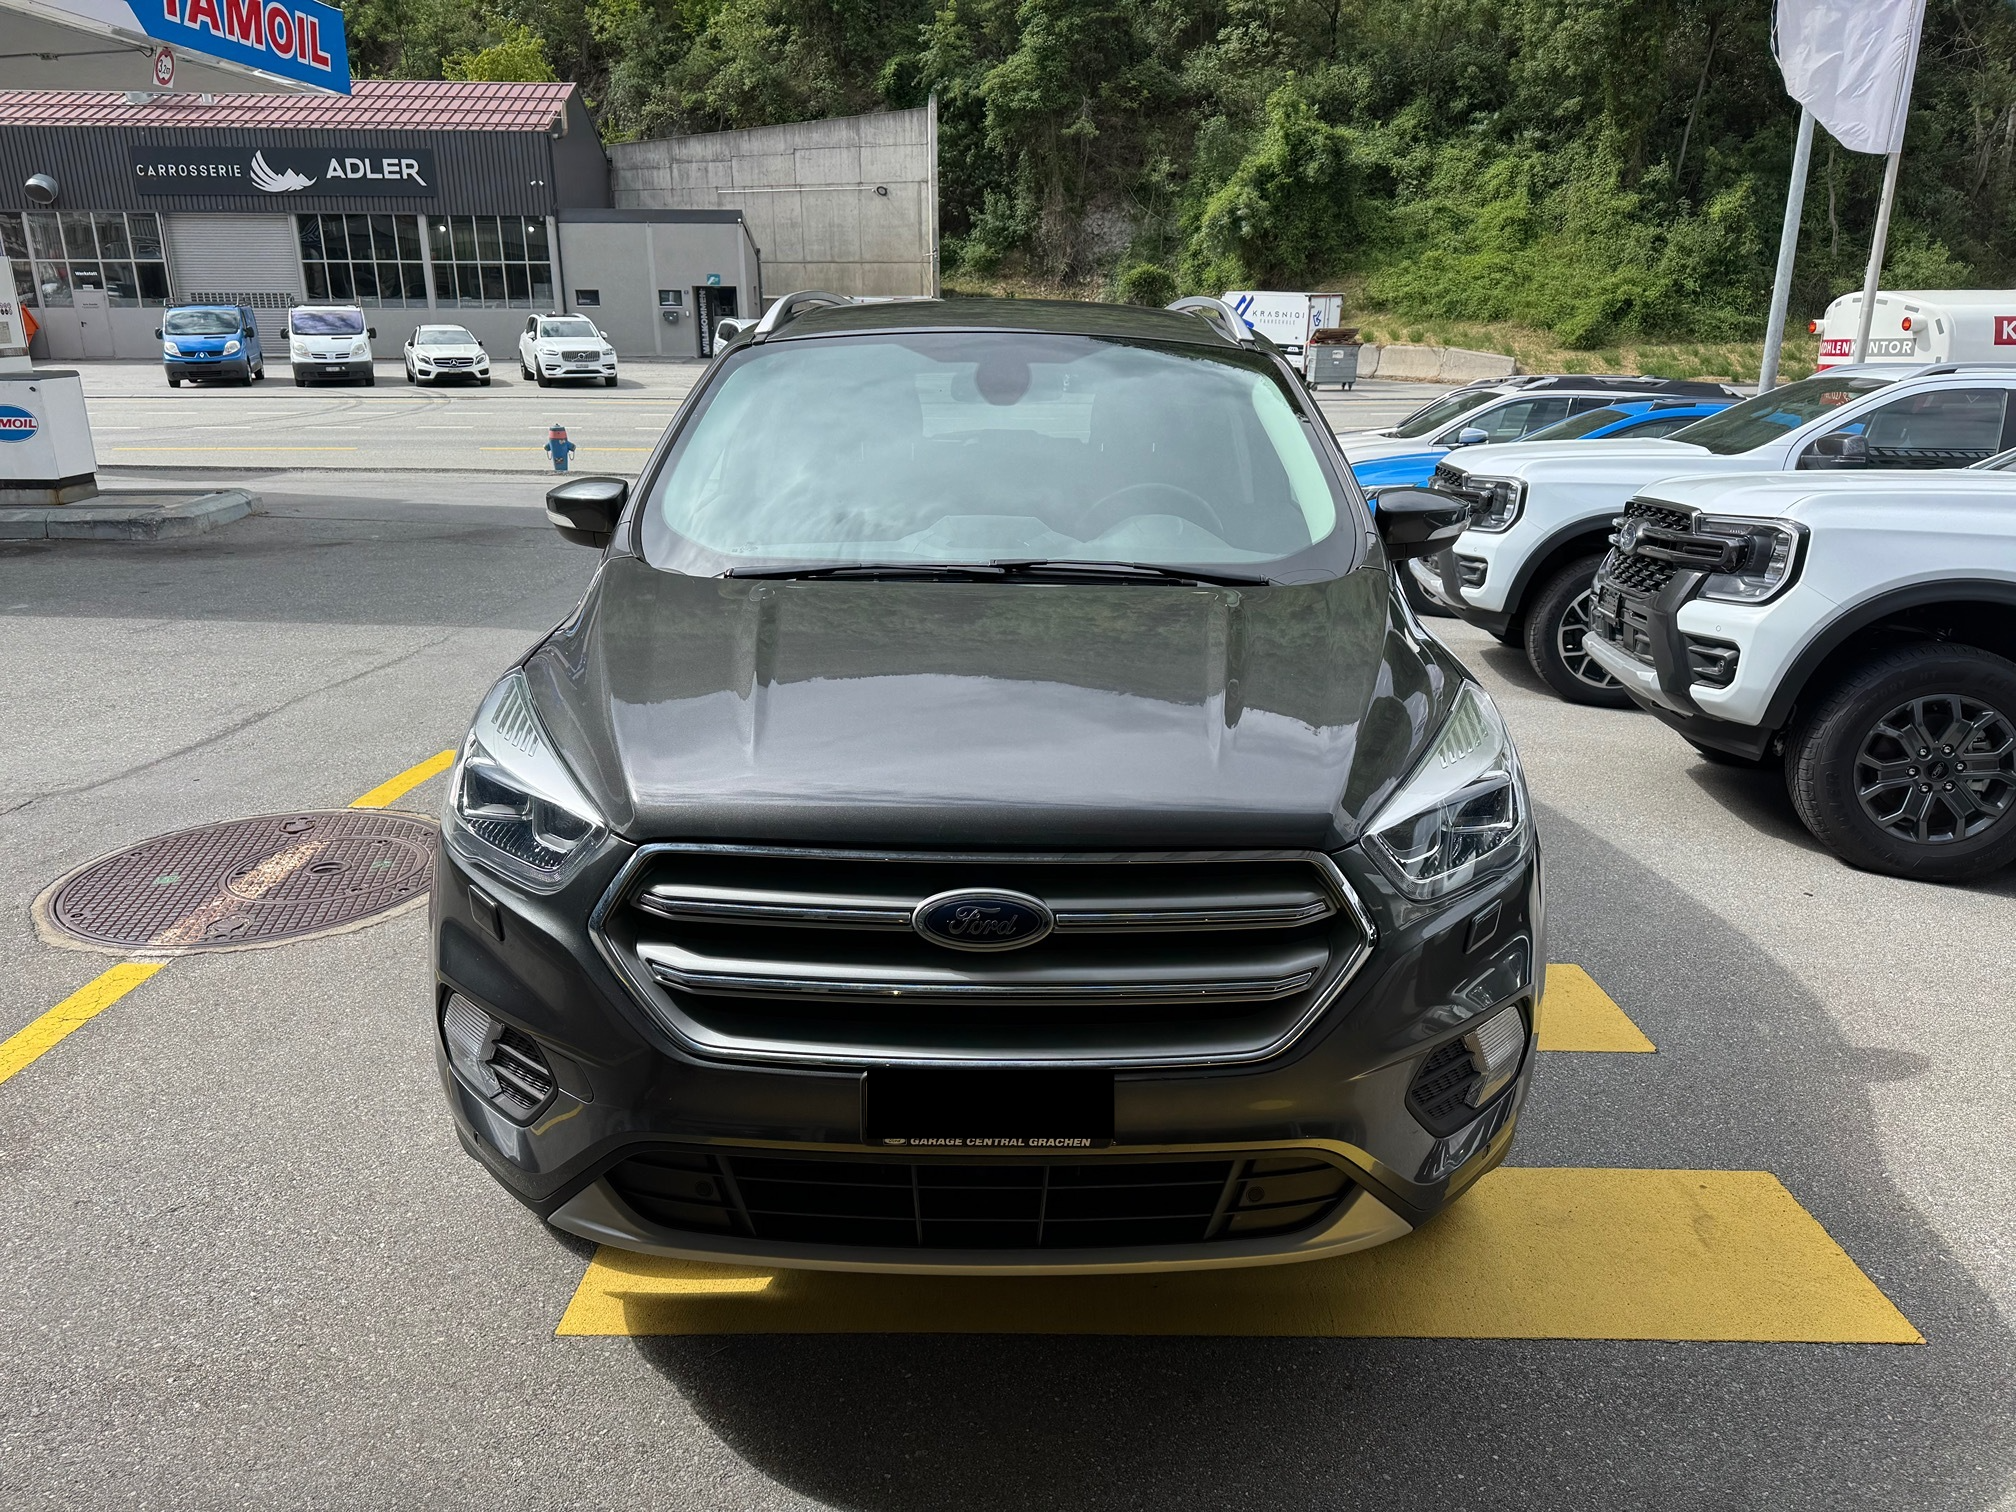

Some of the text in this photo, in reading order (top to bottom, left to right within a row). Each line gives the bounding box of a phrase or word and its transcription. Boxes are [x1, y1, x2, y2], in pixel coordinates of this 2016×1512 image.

[136, 158, 427, 186] CARROSSERIE ADLER
[947, 906, 1018, 935] Ford
[910, 1138, 963, 1146] GARAGE
[966, 1138, 1025, 1146] CENTRAL
